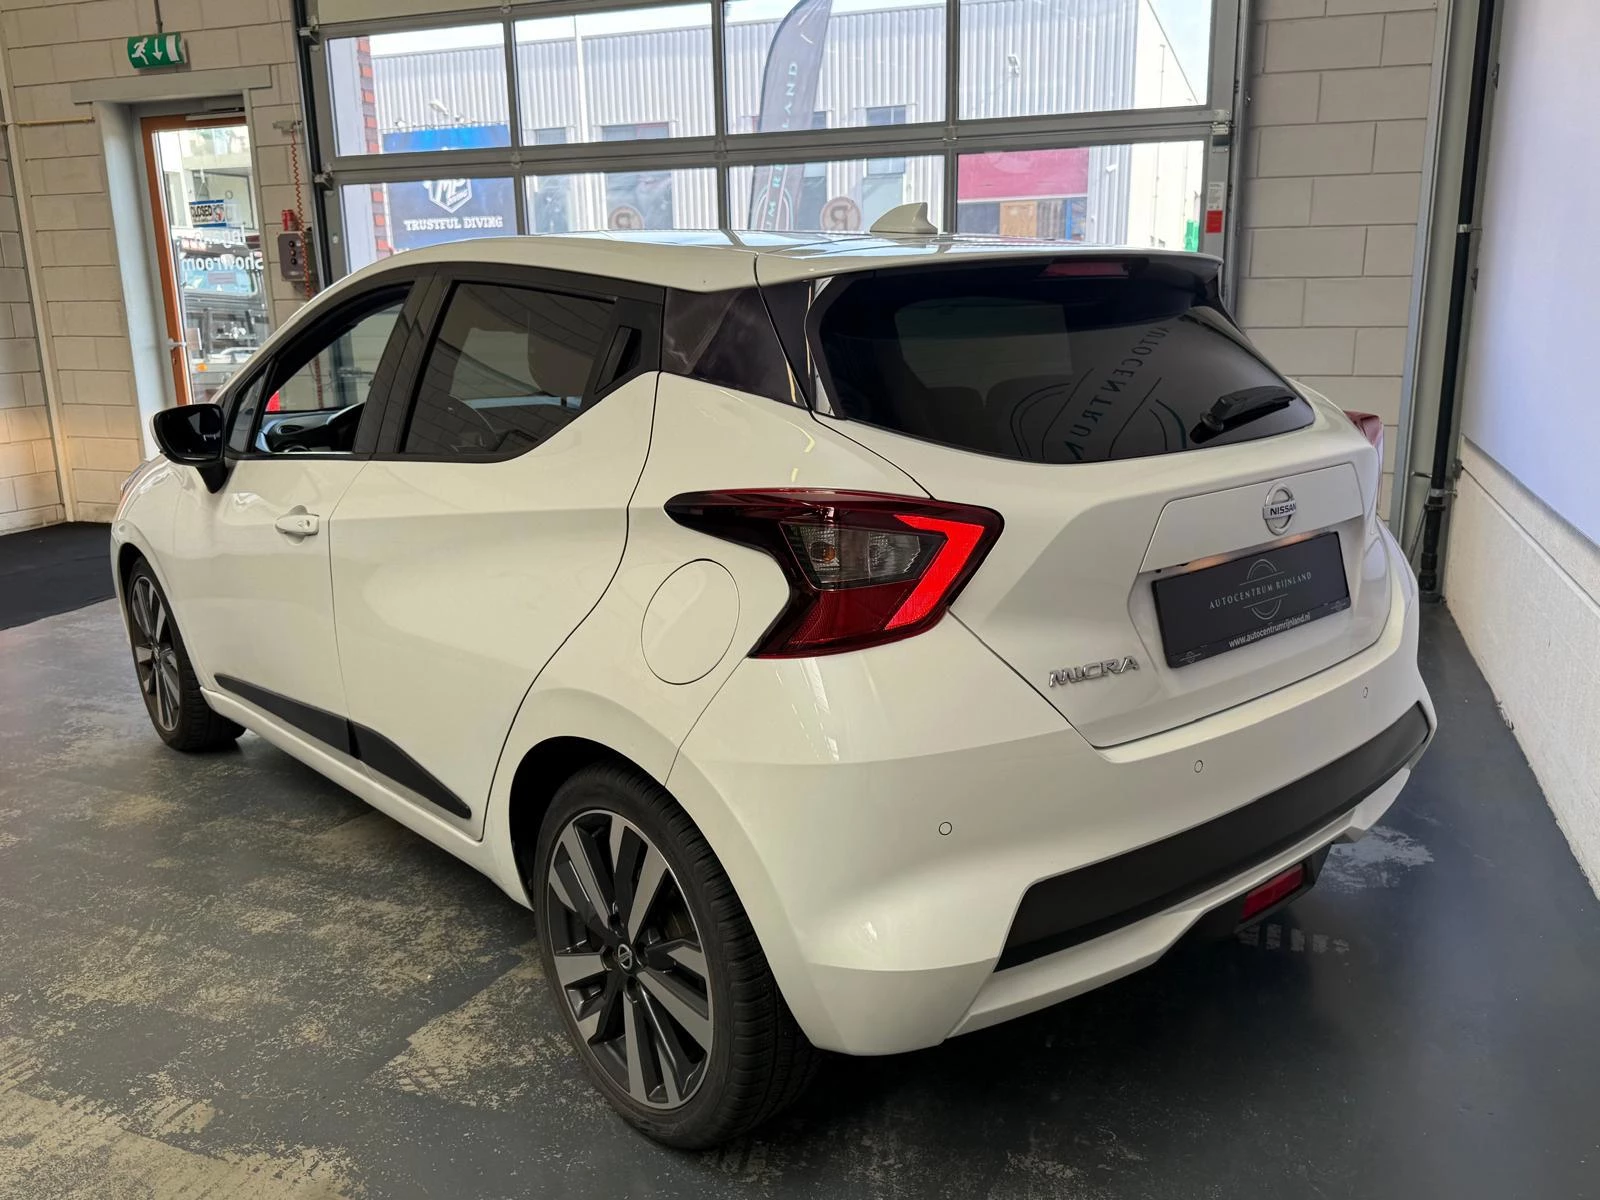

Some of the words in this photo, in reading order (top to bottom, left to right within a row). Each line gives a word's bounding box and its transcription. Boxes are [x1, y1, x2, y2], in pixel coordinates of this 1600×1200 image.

[190, 205, 212, 217] CLOSED
[403, 217, 462, 231] TRUSTFUL
[463, 216, 503, 229] DIVING
[1270, 503, 1296, 516] NISSAN
[1208, 584, 1273, 609] AUTOCENTRUM
[1276, 571, 1312, 590] RIJNLAND
[1228, 611, 1311, 649] www.autocentrumrijnland.nl
[1048, 655, 1140, 688] MICRA
